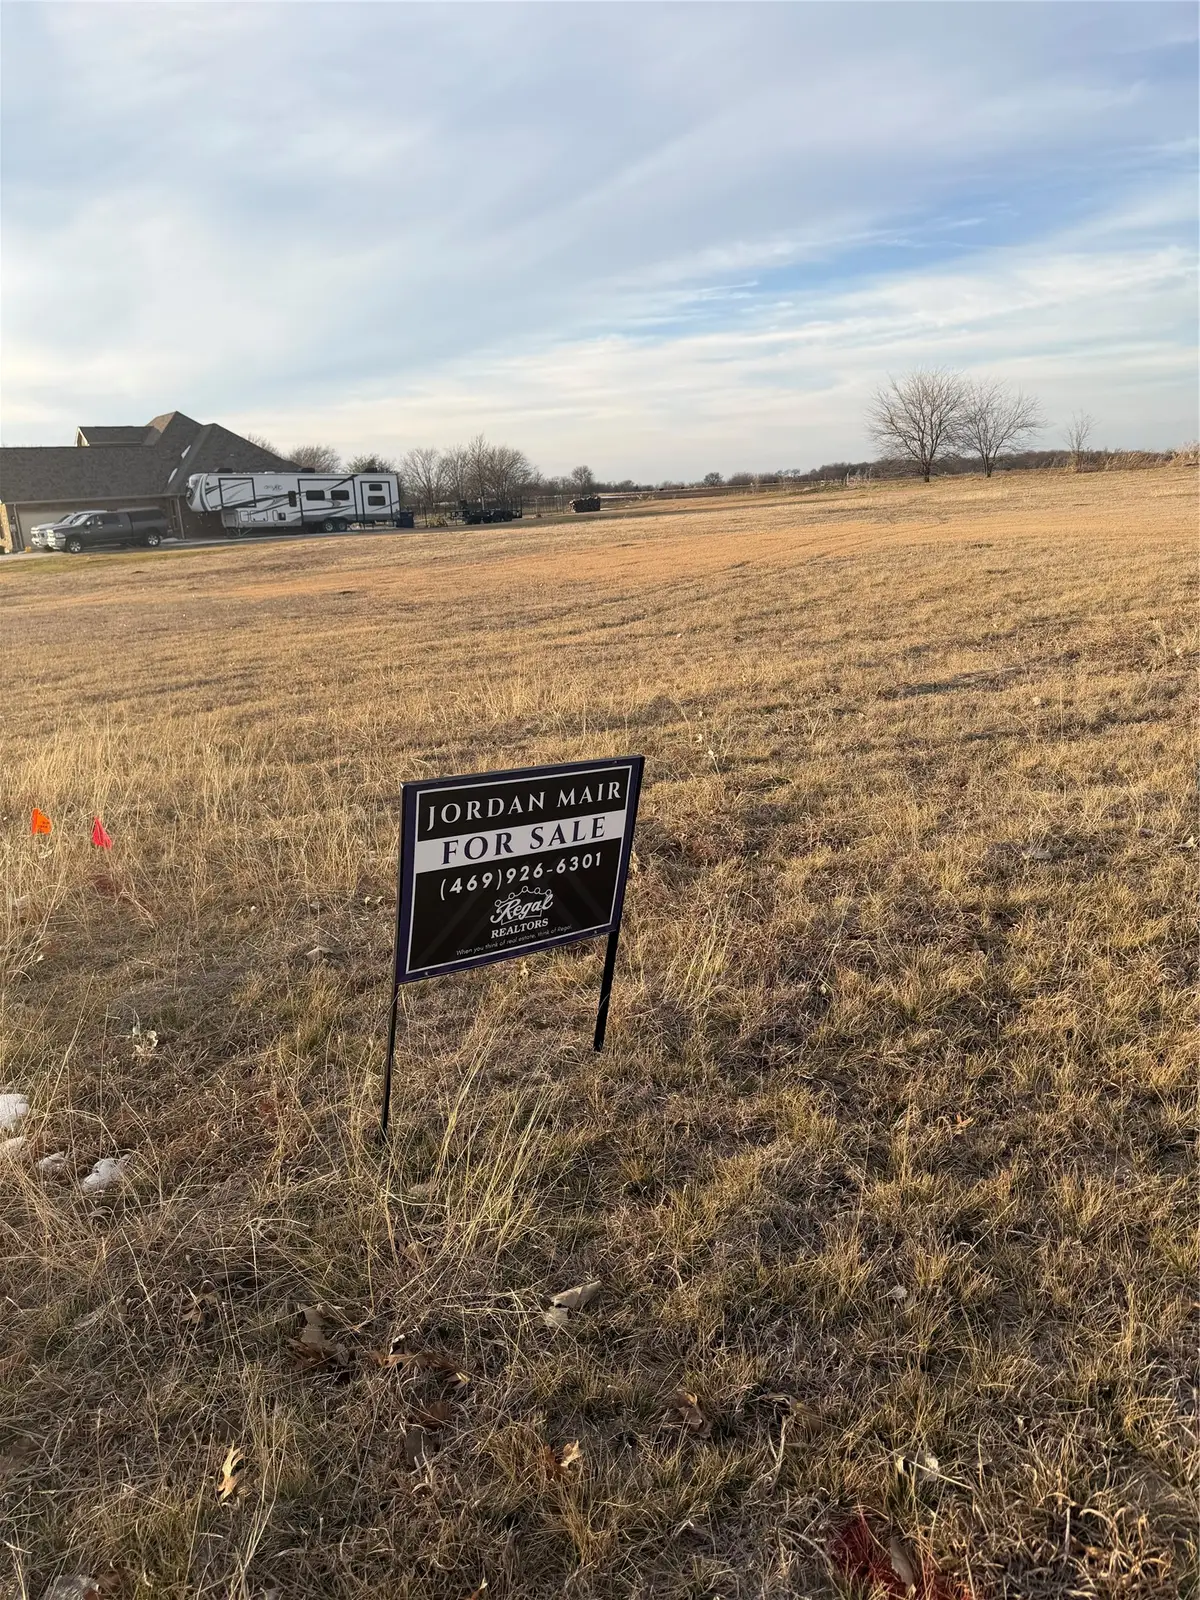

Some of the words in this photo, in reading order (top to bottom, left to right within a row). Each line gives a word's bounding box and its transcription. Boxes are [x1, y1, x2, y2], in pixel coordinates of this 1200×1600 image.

[427, 791, 545, 831] JORDAN
[556, 781, 622, 808] MAIR
[441, 832, 514, 865] FOR
[529, 816, 607, 850] SALE
[440, 852, 603, 901] (469)926-6301
[490, 893, 554, 924] Regal
[491, 917, 549, 939] REALTORS
[456, 947, 472, 956] When
[485, 942, 498, 950] think
